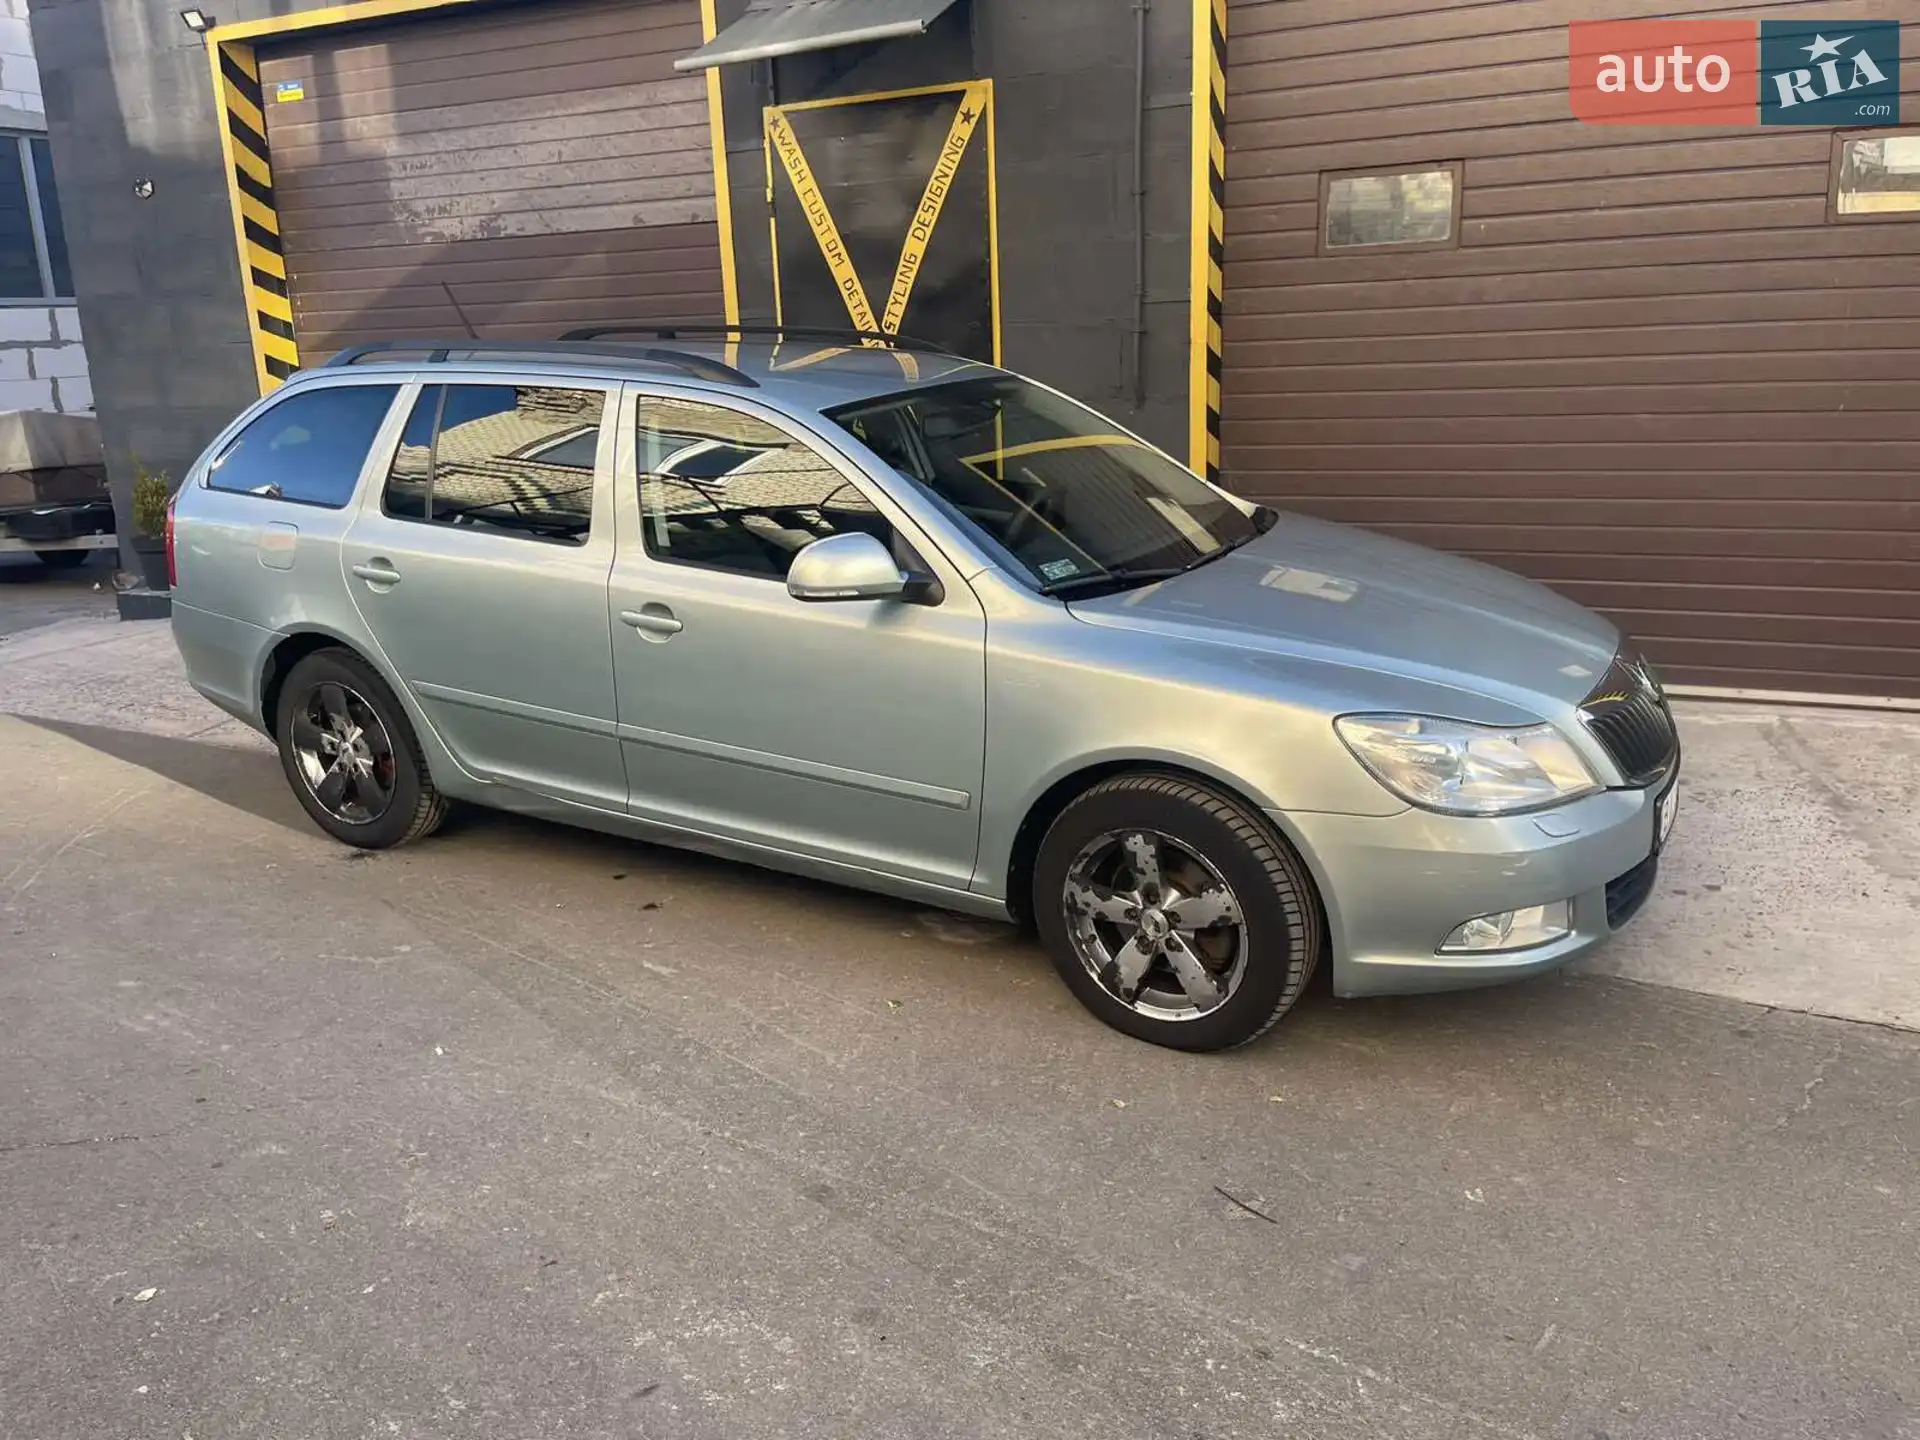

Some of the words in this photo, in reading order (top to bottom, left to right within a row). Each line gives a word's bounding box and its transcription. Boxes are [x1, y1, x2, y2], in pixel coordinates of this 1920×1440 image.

[779, 127, 807, 184] WASH
[802, 187, 845, 268] CUSTOM
[883, 252, 918, 333] STYLING
[911, 134, 965, 242] DESIGNING
